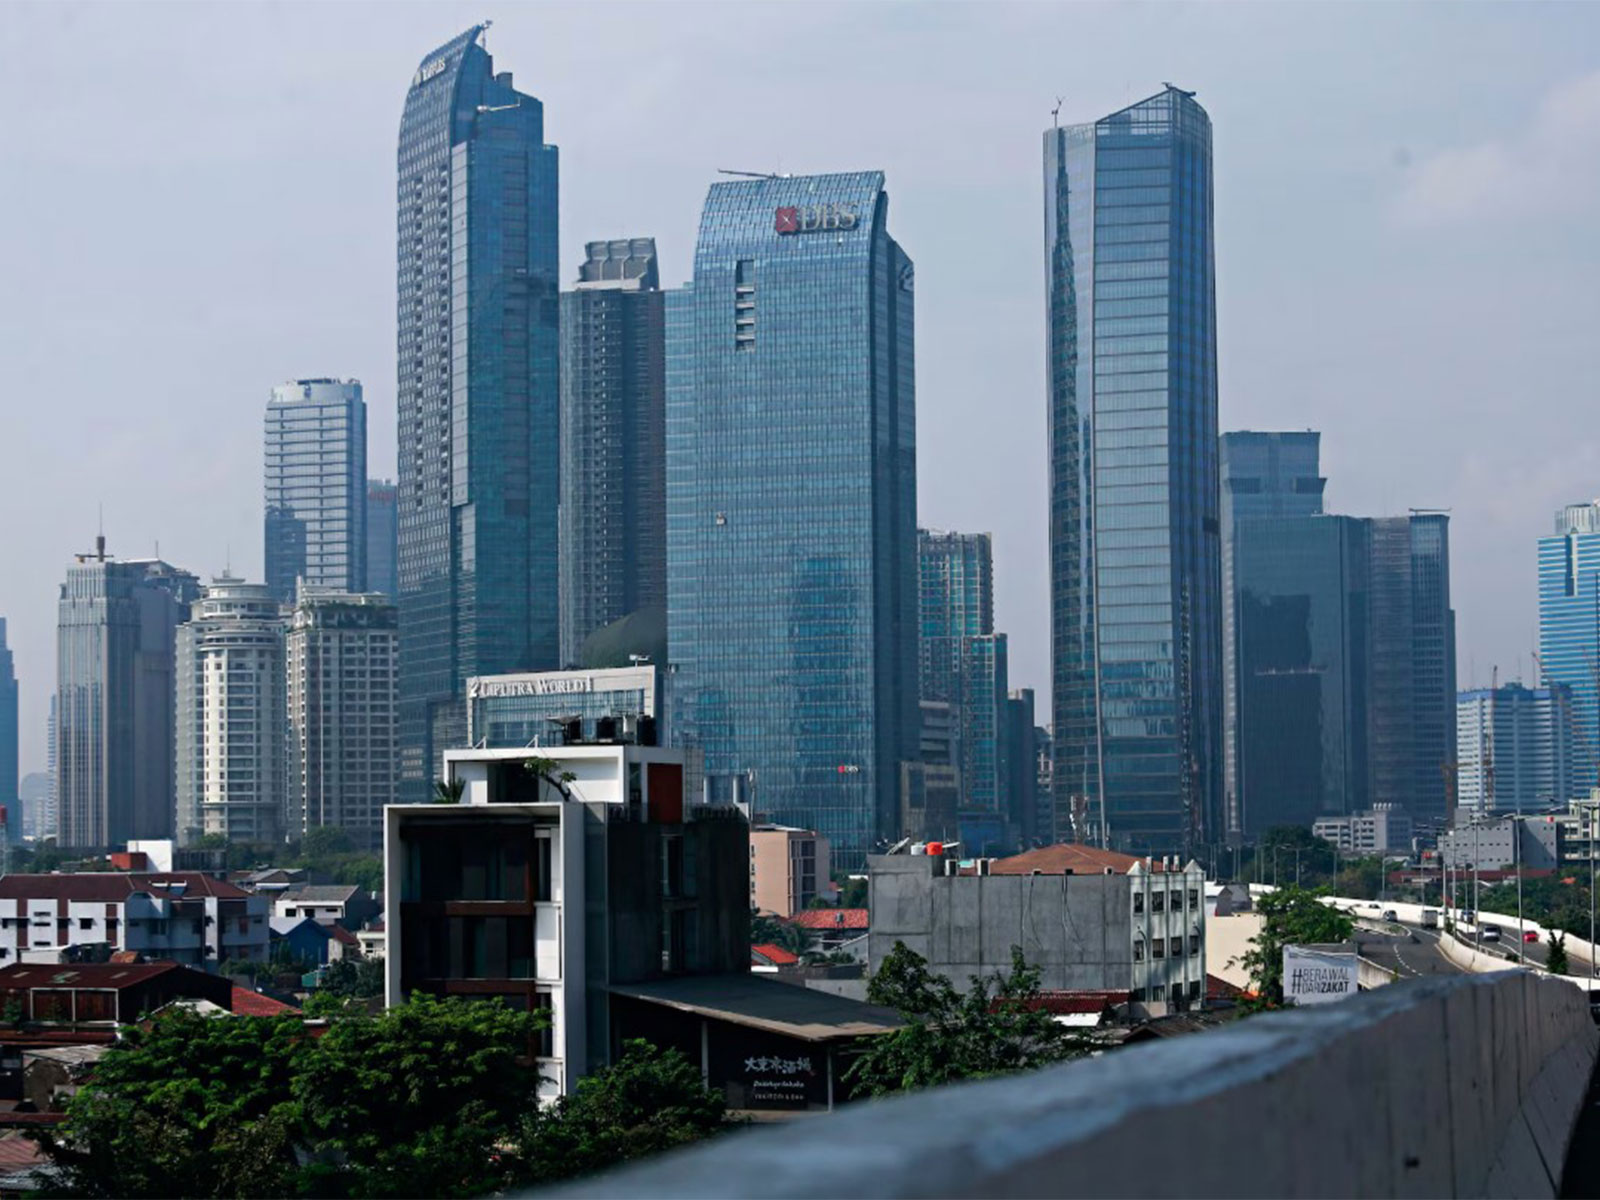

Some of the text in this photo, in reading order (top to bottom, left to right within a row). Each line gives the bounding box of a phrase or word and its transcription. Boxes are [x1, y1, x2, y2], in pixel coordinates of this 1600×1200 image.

[801, 204, 858, 230] DBS
[480, 680, 534, 697] CIPUTRA
[536, 676, 584, 693] WORLD
